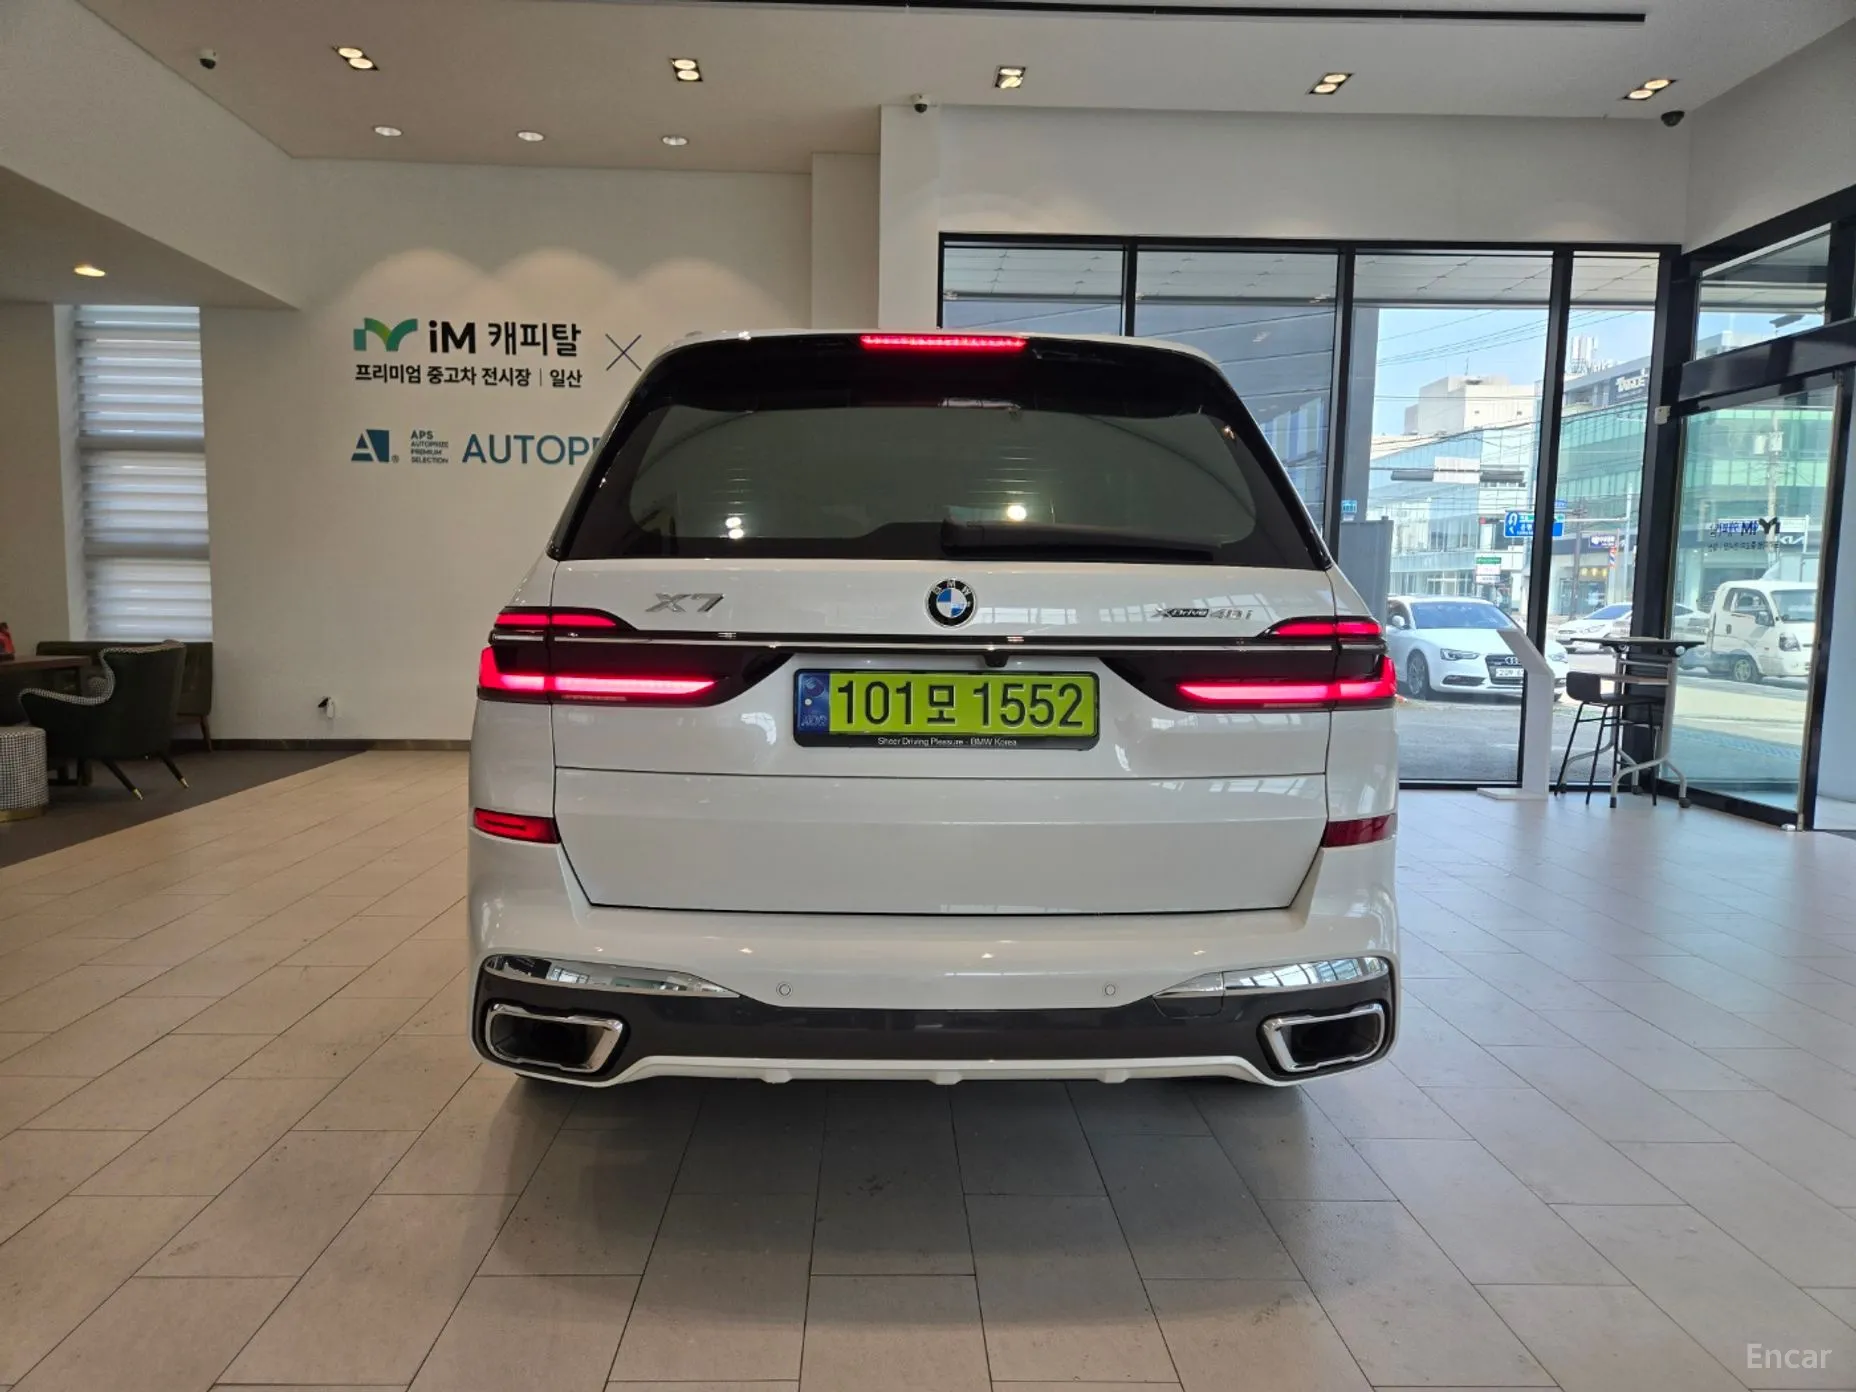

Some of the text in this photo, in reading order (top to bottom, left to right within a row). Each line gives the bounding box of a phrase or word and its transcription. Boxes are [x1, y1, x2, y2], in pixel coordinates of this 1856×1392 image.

[429, 320, 581, 357] iM 캐피탈
[355, 363, 582, 388] 프리미엄 중고차 전시장 일산
[410, 430, 434, 440] APS
[411, 456, 449, 464] SELECTION
[644, 593, 724, 613] X7
[837, 680, 1083, 728] 101모 1552
[901, 737, 929, 747] Driving
[930, 737, 964, 747] Pleasure
[970, 738, 993, 746] BMW
[994, 738, 1017, 747] Korea
